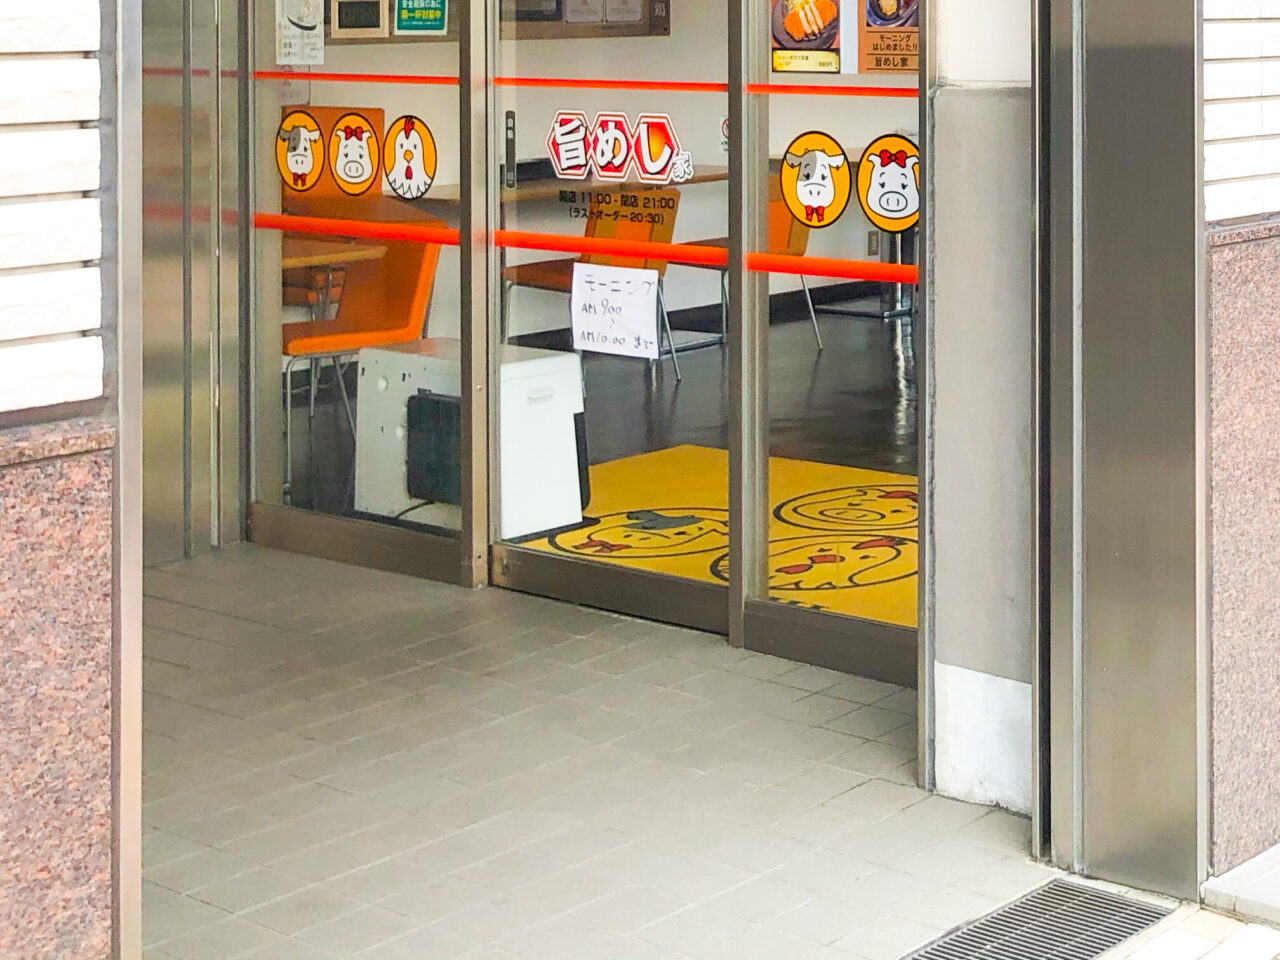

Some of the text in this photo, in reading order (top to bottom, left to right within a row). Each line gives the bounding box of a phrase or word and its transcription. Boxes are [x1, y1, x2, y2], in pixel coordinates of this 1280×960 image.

[875, 57, 909, 68] 旨めし家
[553, 116, 693, 180] 旨めし家
[580, 191, 612, 205] 11:00
[643, 196, 675, 210] 21:00
